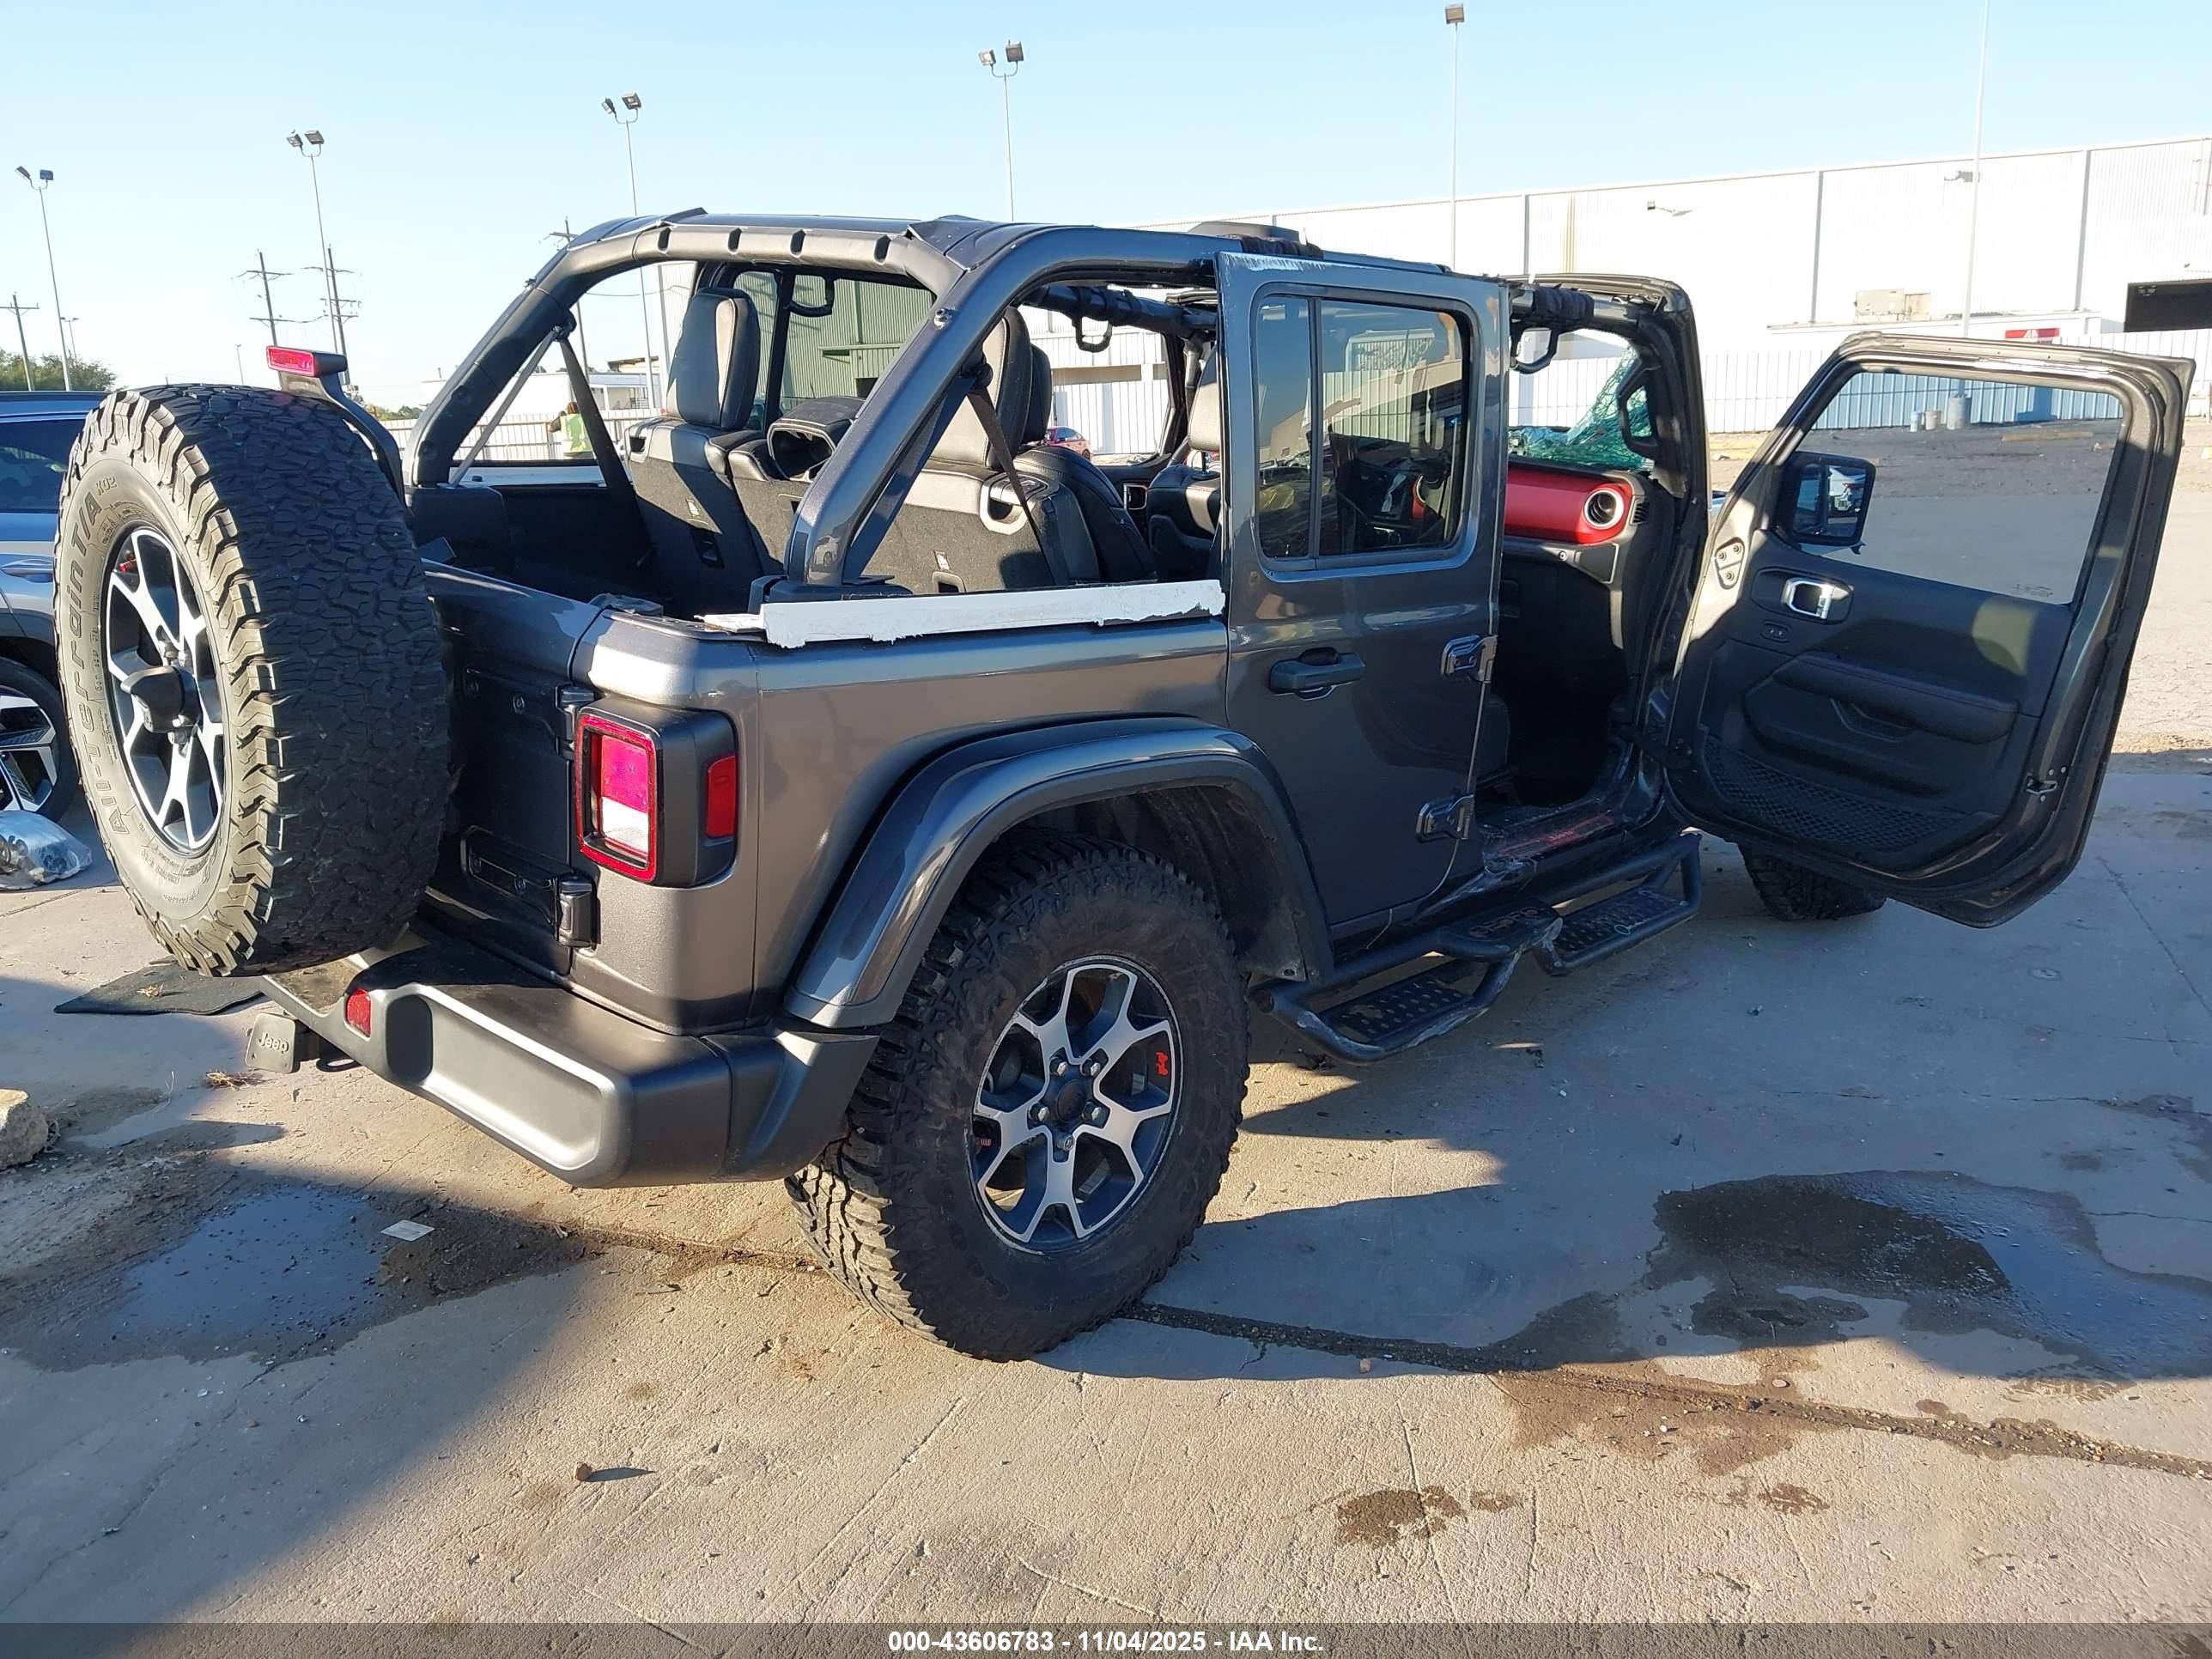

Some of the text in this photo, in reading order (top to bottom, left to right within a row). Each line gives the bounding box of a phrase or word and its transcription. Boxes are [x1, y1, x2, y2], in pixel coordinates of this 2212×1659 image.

[71, 491, 103, 557] T/A
[66, 559, 131, 835] All-Terrain
[258, 1032, 289, 1054] Jeep
